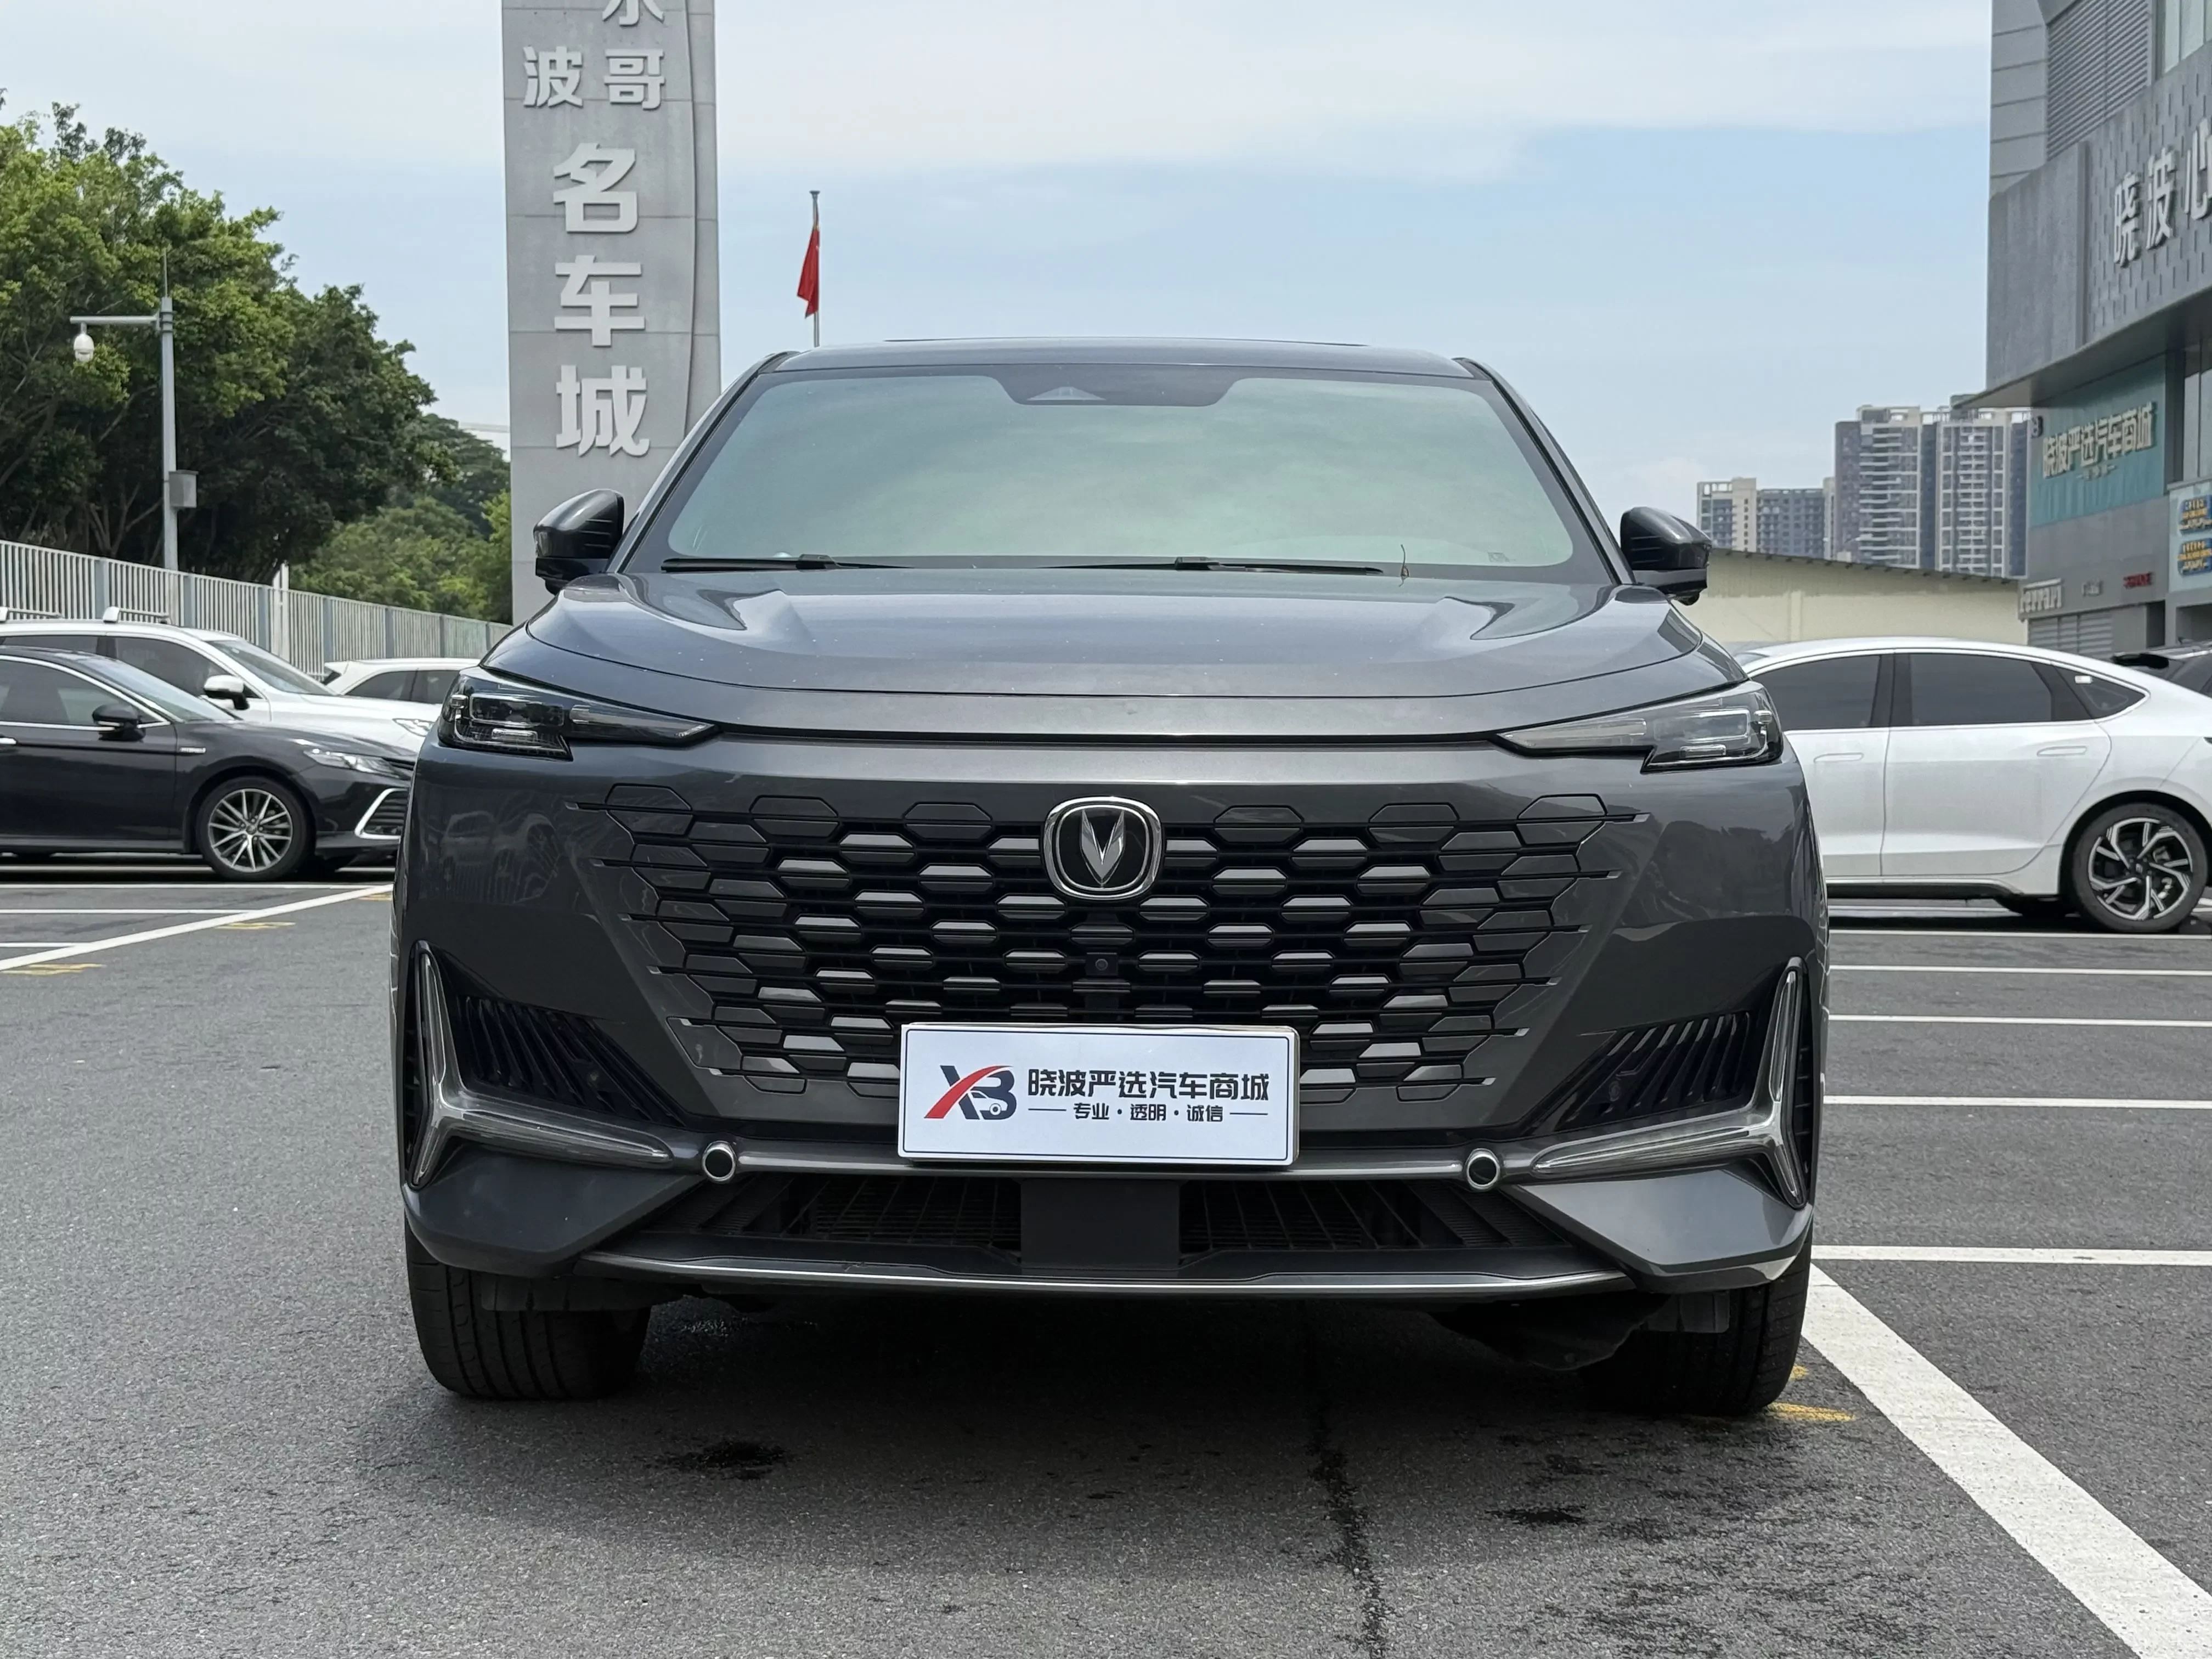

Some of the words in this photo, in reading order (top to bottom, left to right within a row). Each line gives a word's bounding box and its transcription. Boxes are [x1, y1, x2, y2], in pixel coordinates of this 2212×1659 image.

[553, 143, 650, 457] 名车城
[1028, 1069, 1269, 1101] 晓波严选汽车商城
